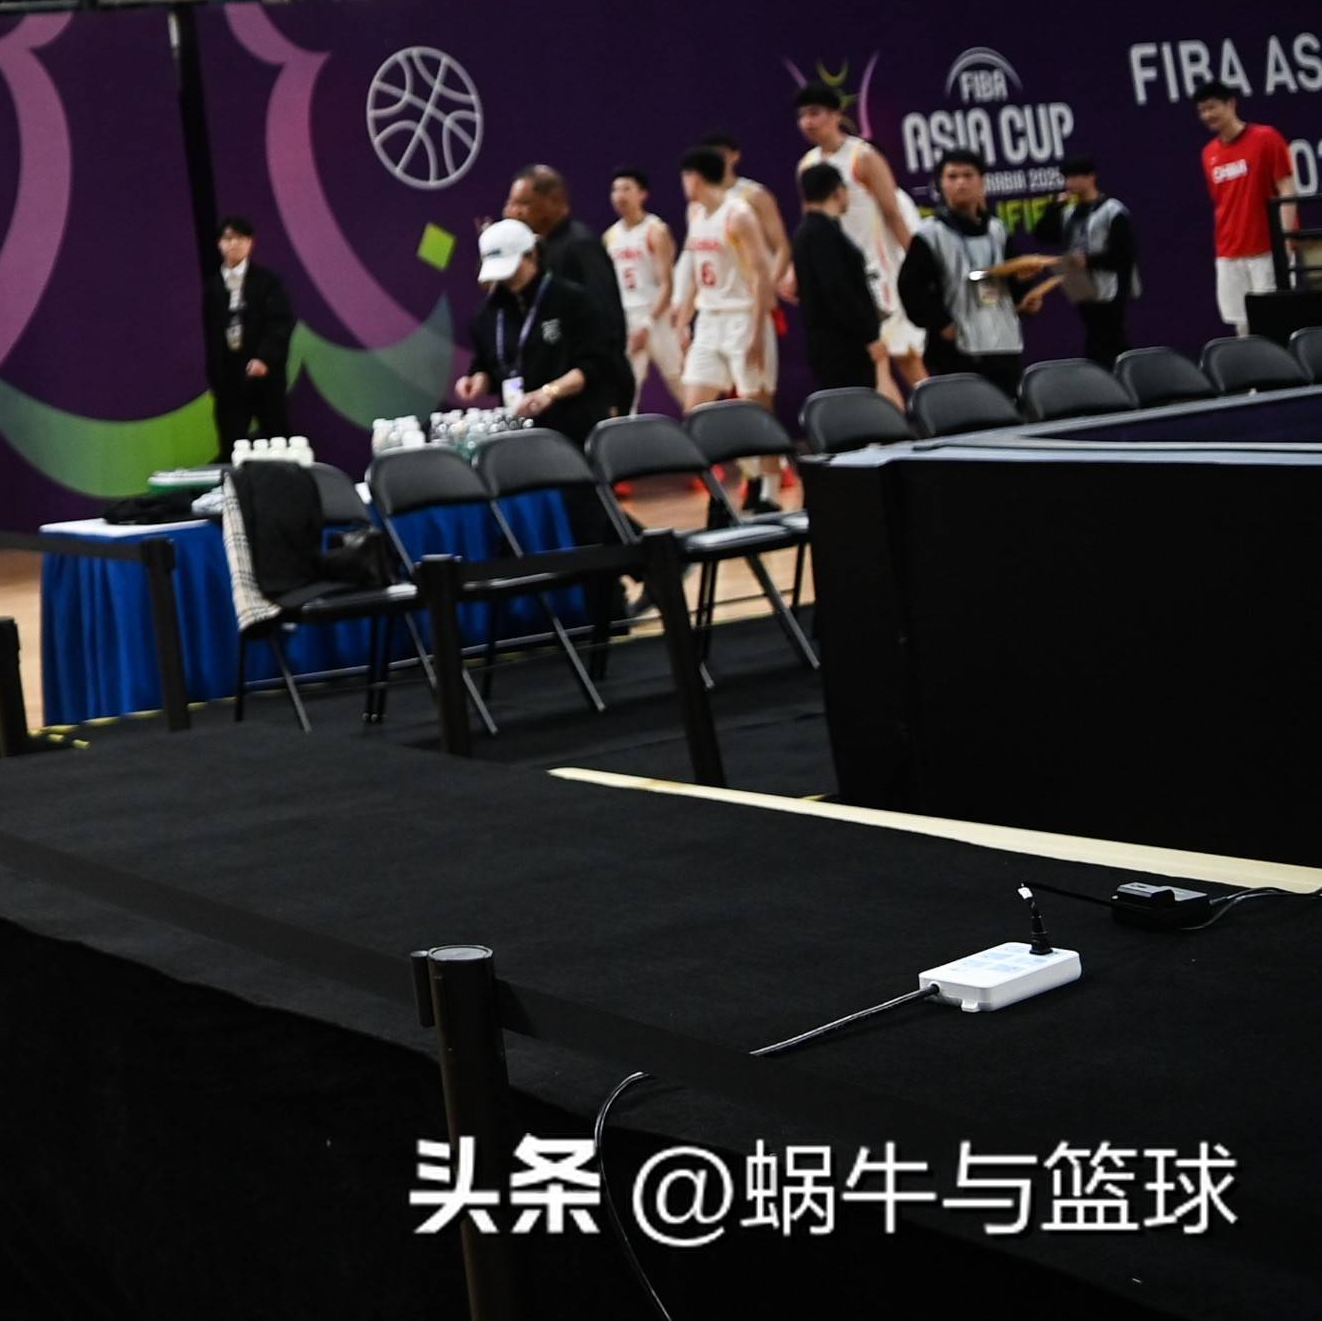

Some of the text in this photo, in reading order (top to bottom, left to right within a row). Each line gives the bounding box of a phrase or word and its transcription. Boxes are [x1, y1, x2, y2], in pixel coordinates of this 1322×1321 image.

[961, 68, 1007, 102] FIBA
[1129, 39, 1252, 105] FIBA
[903, 102, 1073, 173] ASIA CUP
